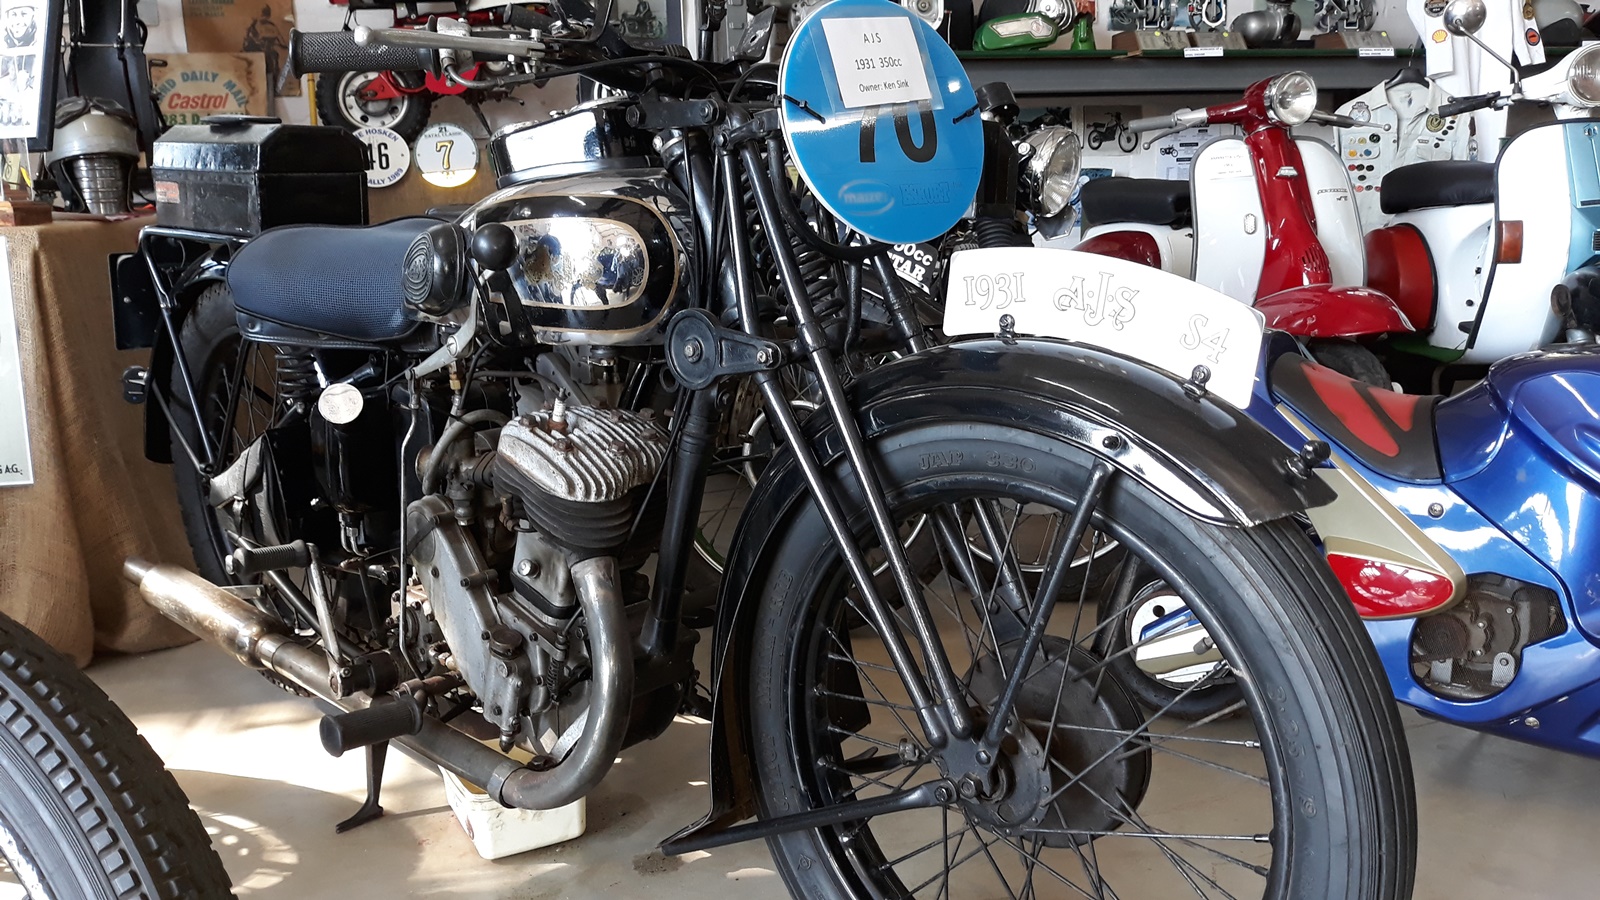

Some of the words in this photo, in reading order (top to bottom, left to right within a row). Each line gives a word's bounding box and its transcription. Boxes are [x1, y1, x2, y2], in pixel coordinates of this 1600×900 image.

[855, 58, 876, 70] 1931
[879, 57, 903, 69] 350cc
[181, 71, 219, 83] DAILY
[223, 80, 248, 108] MAIL
[859, 82, 883, 92] Owner:
[883, 81, 896, 90] Ken
[897, 79, 910, 89] Sink
[168, 92, 229, 110] Castrol
[365, 128, 399, 142] HOSKEN
[435, 139, 454, 170] 7
[387, 167, 404, 183] 1989
[963, 272, 1026, 310] 1931
[1179, 313, 1230, 364] S4
